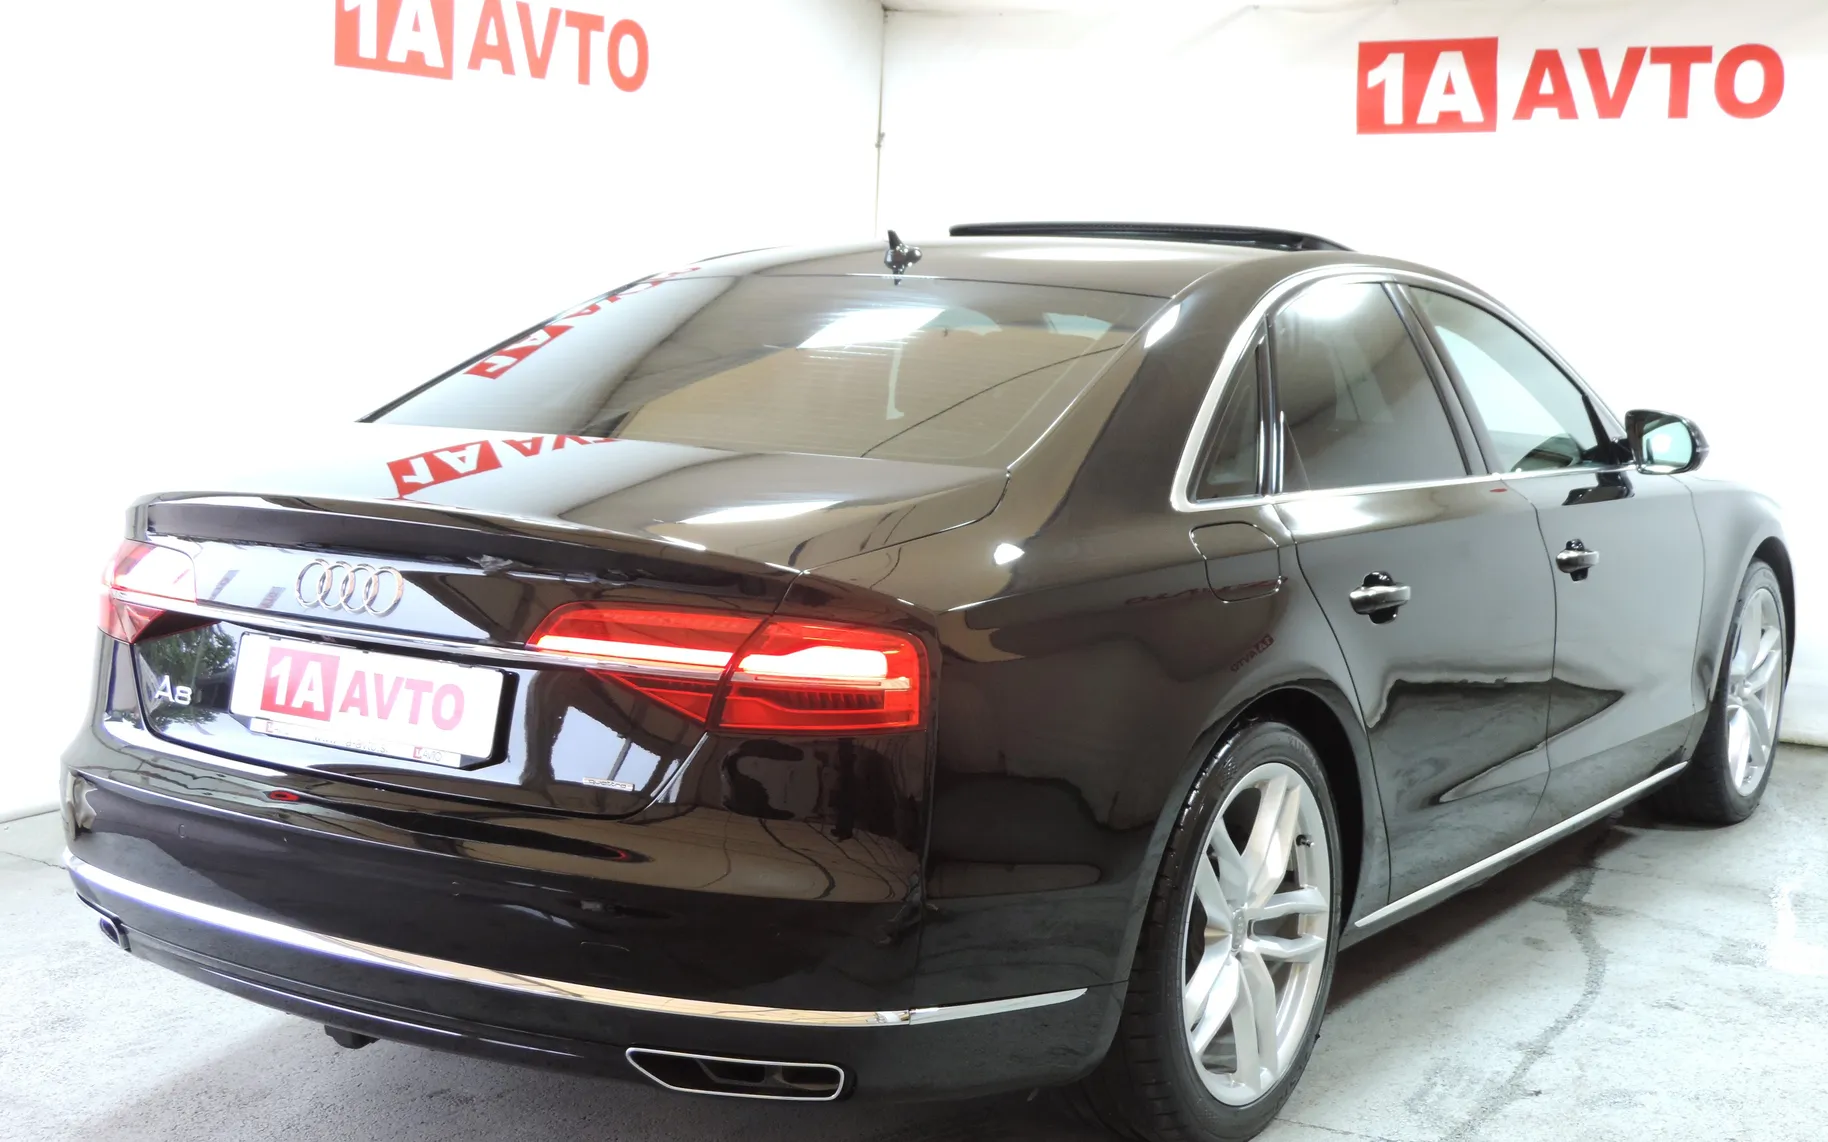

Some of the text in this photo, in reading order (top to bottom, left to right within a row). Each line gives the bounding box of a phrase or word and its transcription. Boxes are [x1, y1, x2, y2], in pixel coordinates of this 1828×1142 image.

[343, 0, 649, 93] 1A AVTO
[1366, 43, 1785, 126] 1A AVTO
[154, 674, 192, 706] A8
[269, 654, 465, 731] 1A AVTO
